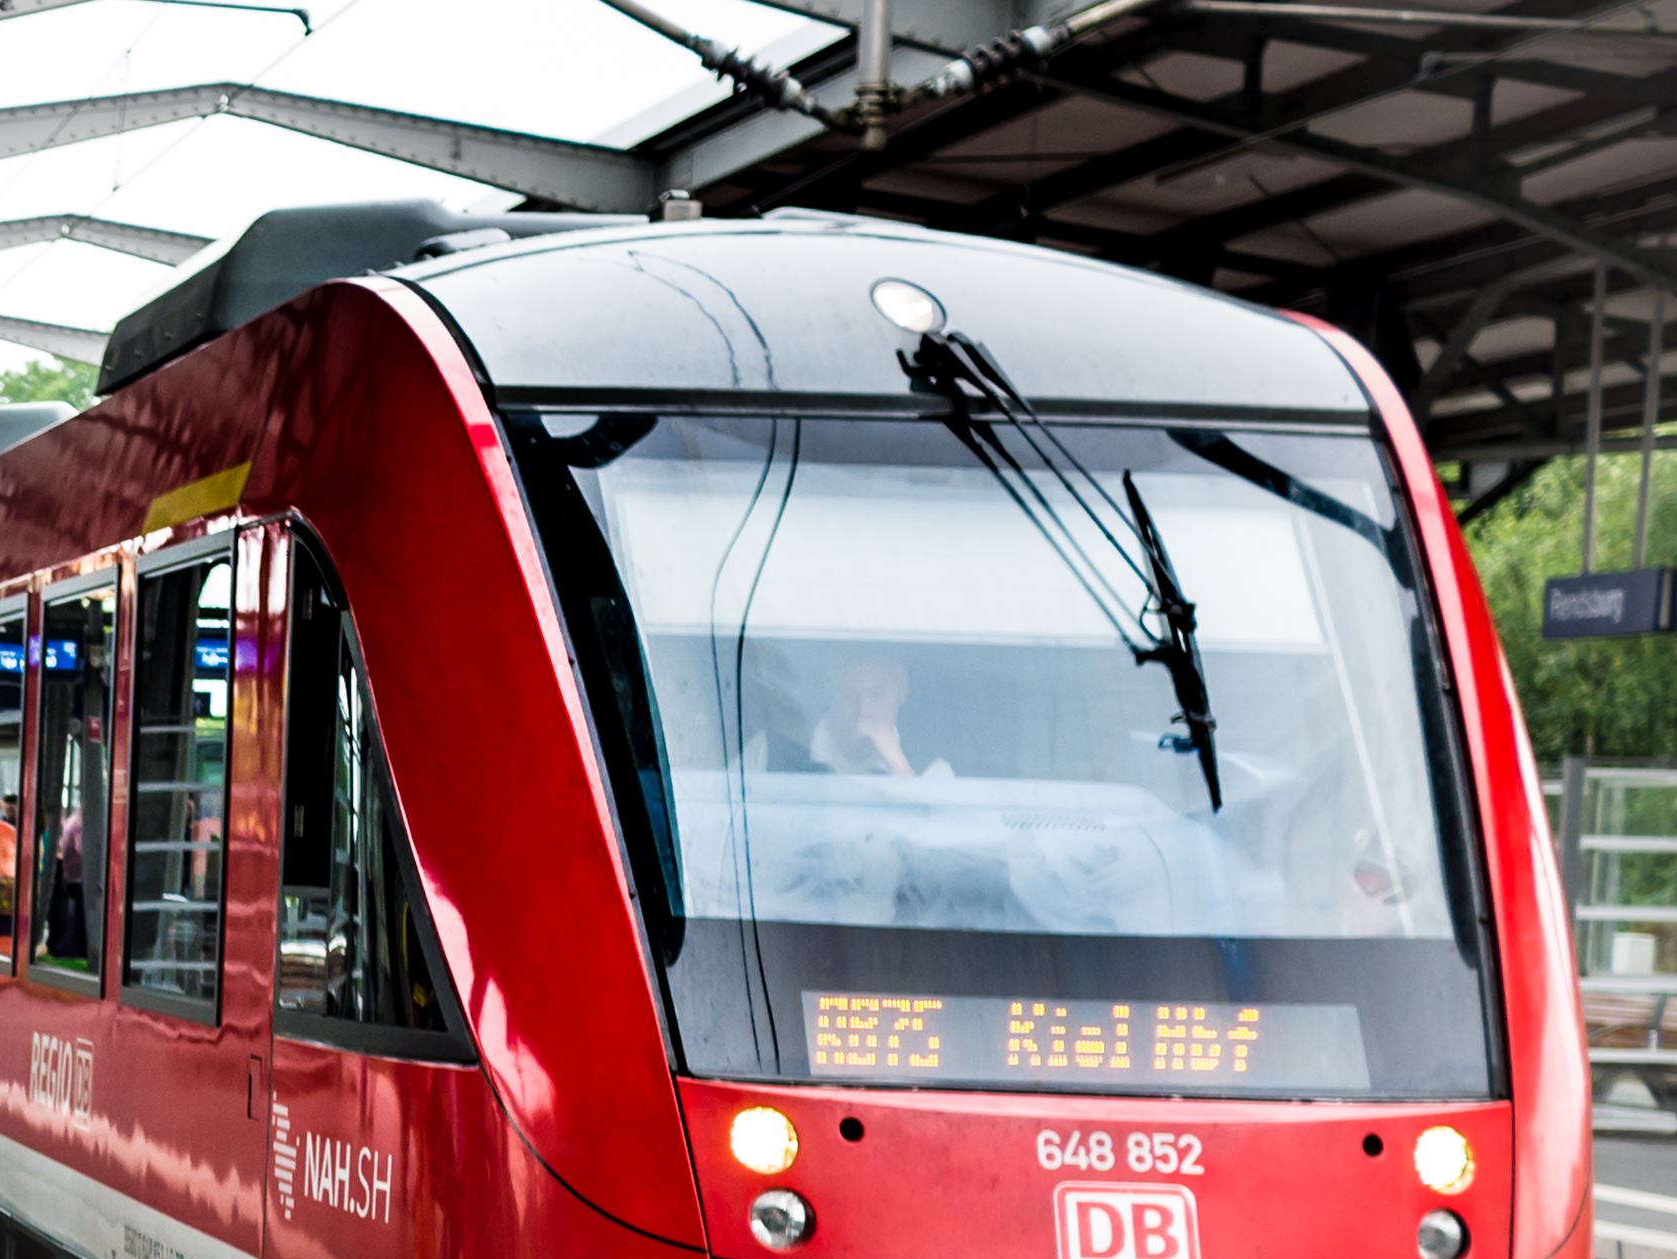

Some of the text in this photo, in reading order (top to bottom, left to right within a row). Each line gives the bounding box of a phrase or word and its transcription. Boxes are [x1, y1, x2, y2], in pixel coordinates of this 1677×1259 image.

[29, 1031, 73, 1115] REGIO
[1007, 1002, 1131, 1069] Kiel
[1154, 1006, 1259, 1072] Hbf
[304, 1130, 393, 1224] NAH.SH
[1036, 1129, 1205, 1175] 648 852
